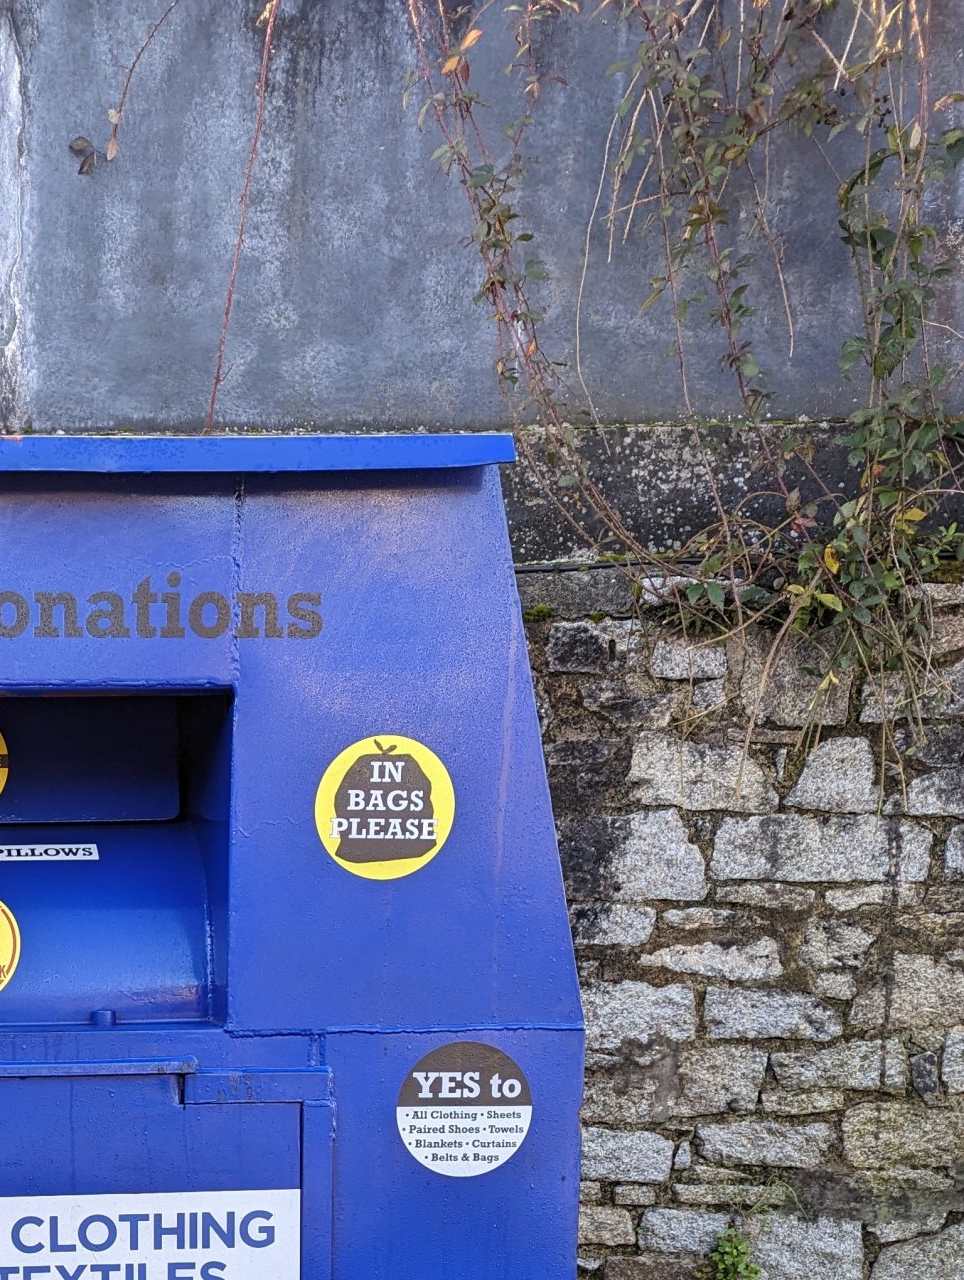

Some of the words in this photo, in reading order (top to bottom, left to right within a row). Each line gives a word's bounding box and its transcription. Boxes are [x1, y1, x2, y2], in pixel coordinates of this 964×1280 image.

[370, 761, 405, 782] IN
[347, 790, 424, 811] BAGS
[329, 818, 438, 839] PLEASE
[413, 1072, 480, 1098] YES
[490, 1073, 521, 1098] to
[412, 1111, 427, 1119] All
[431, 1111, 477, 1121] Clothing
[487, 1111, 521, 1119] Sheets
[409, 1125, 445, 1133] Paired
[448, 1125, 480, 1133] Shoes
[488, 1125, 524, 1133] Towels
[415, 1139, 463, 1148] Blankets
[431, 1153, 458, 1161] Belts
[461, 1153, 469, 1161] &
[473, 1153, 499, 1163] Bags
[11, 1210, 275, 1254] CLOTHING
